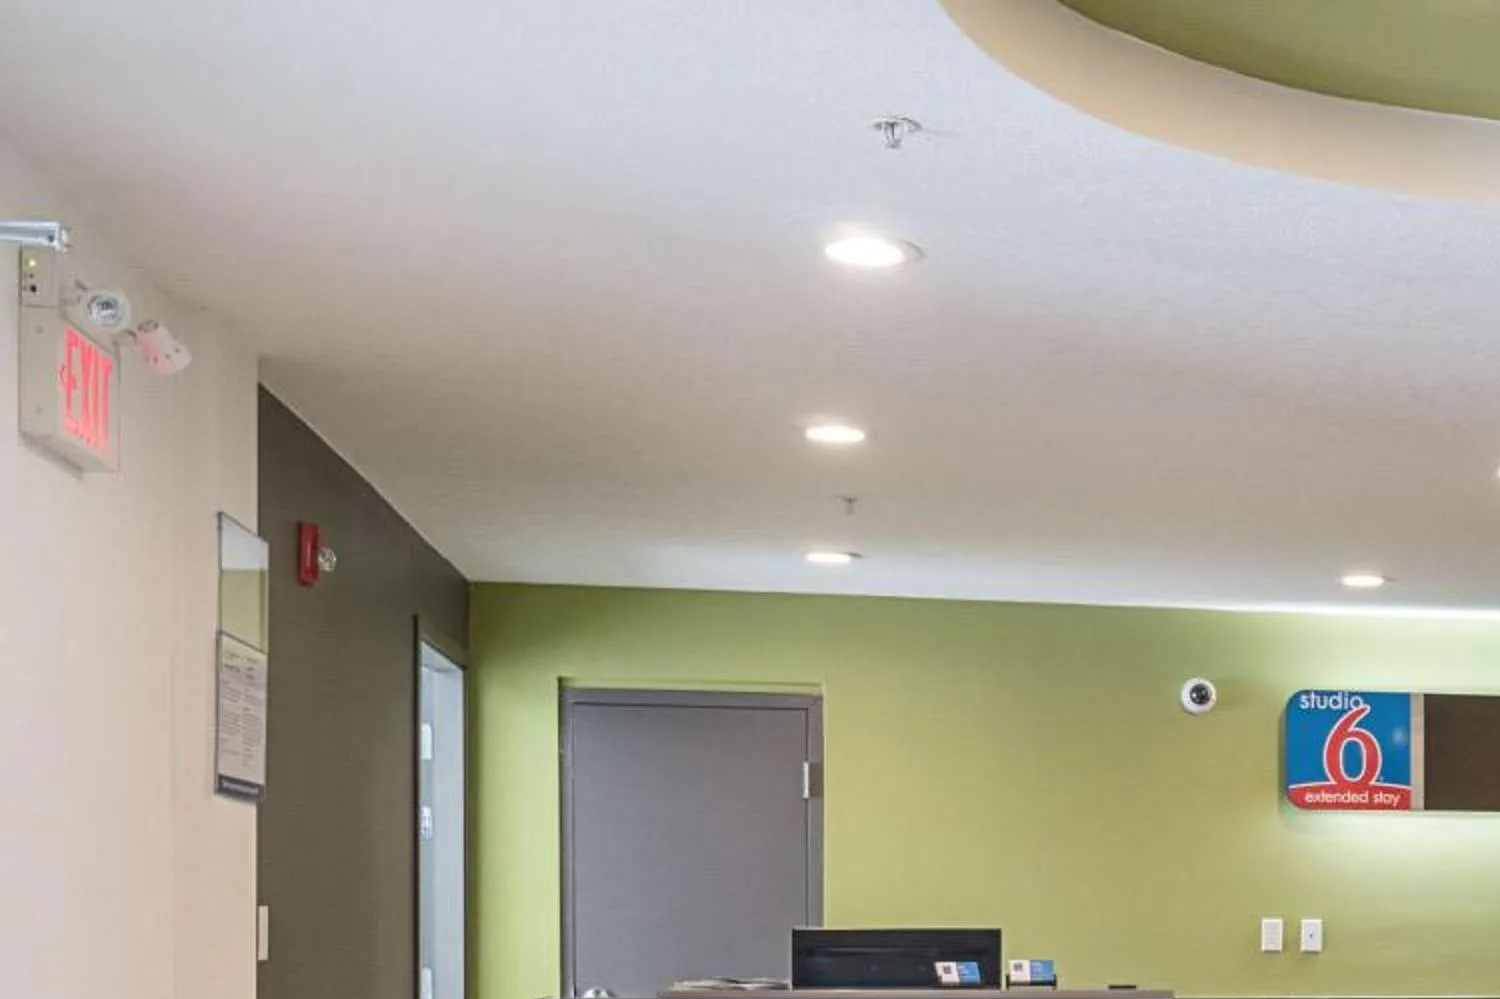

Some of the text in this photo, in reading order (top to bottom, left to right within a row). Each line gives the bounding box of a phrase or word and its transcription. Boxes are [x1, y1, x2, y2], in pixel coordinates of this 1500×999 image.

[64, 328, 113, 453] EXIT
[1300, 691, 1365, 710] studio
[1322, 704, 1383, 784] 6
[1305, 789, 1401, 807] extended stay
